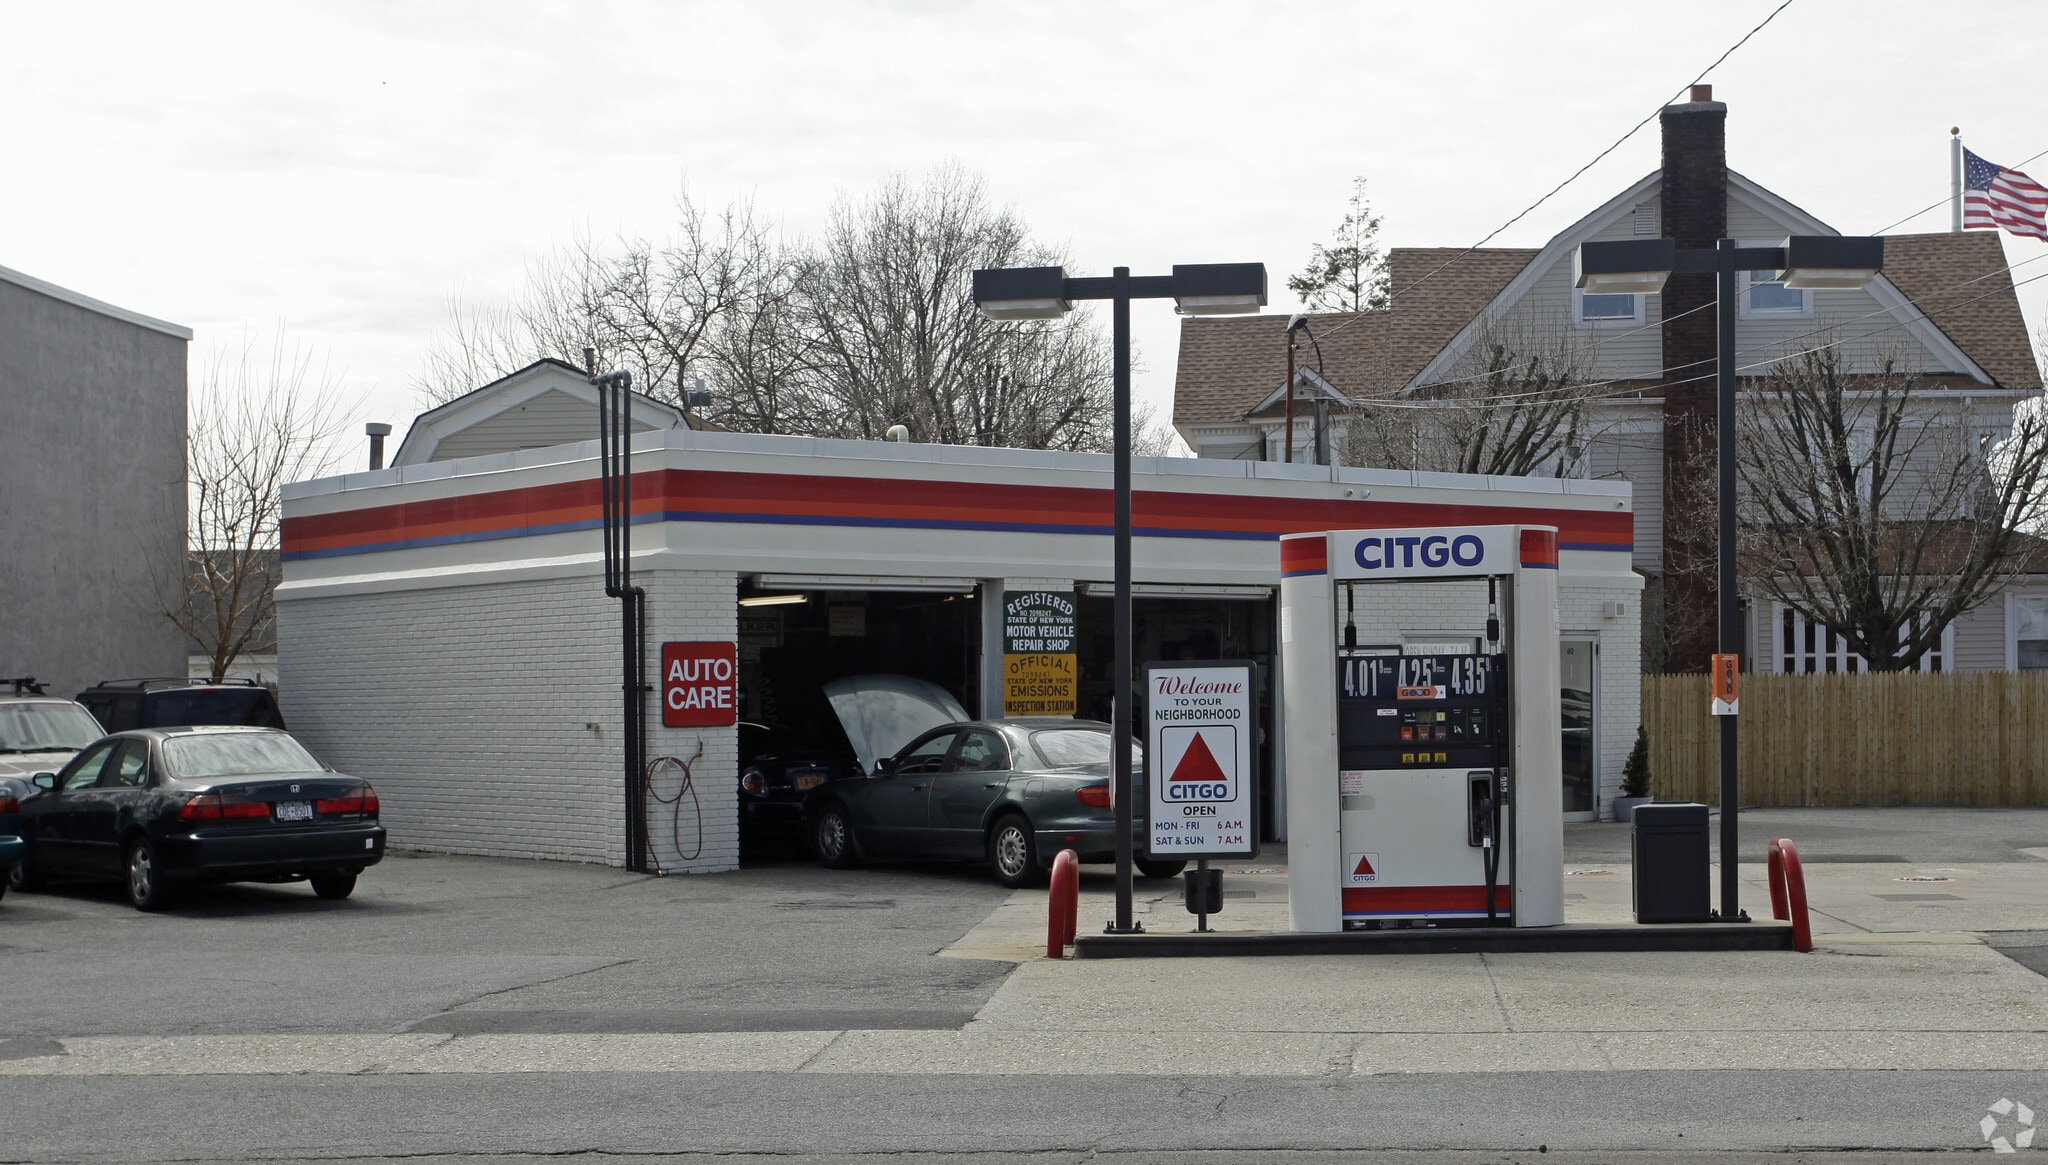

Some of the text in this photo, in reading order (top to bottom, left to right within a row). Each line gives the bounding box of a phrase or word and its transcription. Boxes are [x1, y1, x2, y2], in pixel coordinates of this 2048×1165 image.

[1354, 534, 1484, 569] CITGO
[1007, 592, 1073, 615] REGISTERED
[1006, 626, 1074, 637] MOTOR VEHICLE
[1013, 640, 1070, 651] REPAIR SHOP
[668, 658, 732, 681] AUTO
[1010, 656, 1070, 674] OFFICIAL
[1399, 658, 1431, 686] 425
[1153, 676, 1242, 695] Welcome
[1011, 686, 1069, 697] EMISSIONS
[668, 686, 732, 709] CARE
[1192, 698, 1222, 706] YOUR
[1005, 701, 1074, 712] INSPECTION STATION
[1155, 709, 1241, 720] NEIGHBORHOOD
[1169, 784, 1227, 800] CITGO
[1183, 806, 1216, 816] OPEN
[1155, 822, 1178, 830] MON
[1186, 821, 1200, 830] FRI
[1217, 821, 1222, 829] 6
[1225, 821, 1244, 829] A.M.
[1156, 836, 1244, 845] SAT & SUN 7 A.M.
